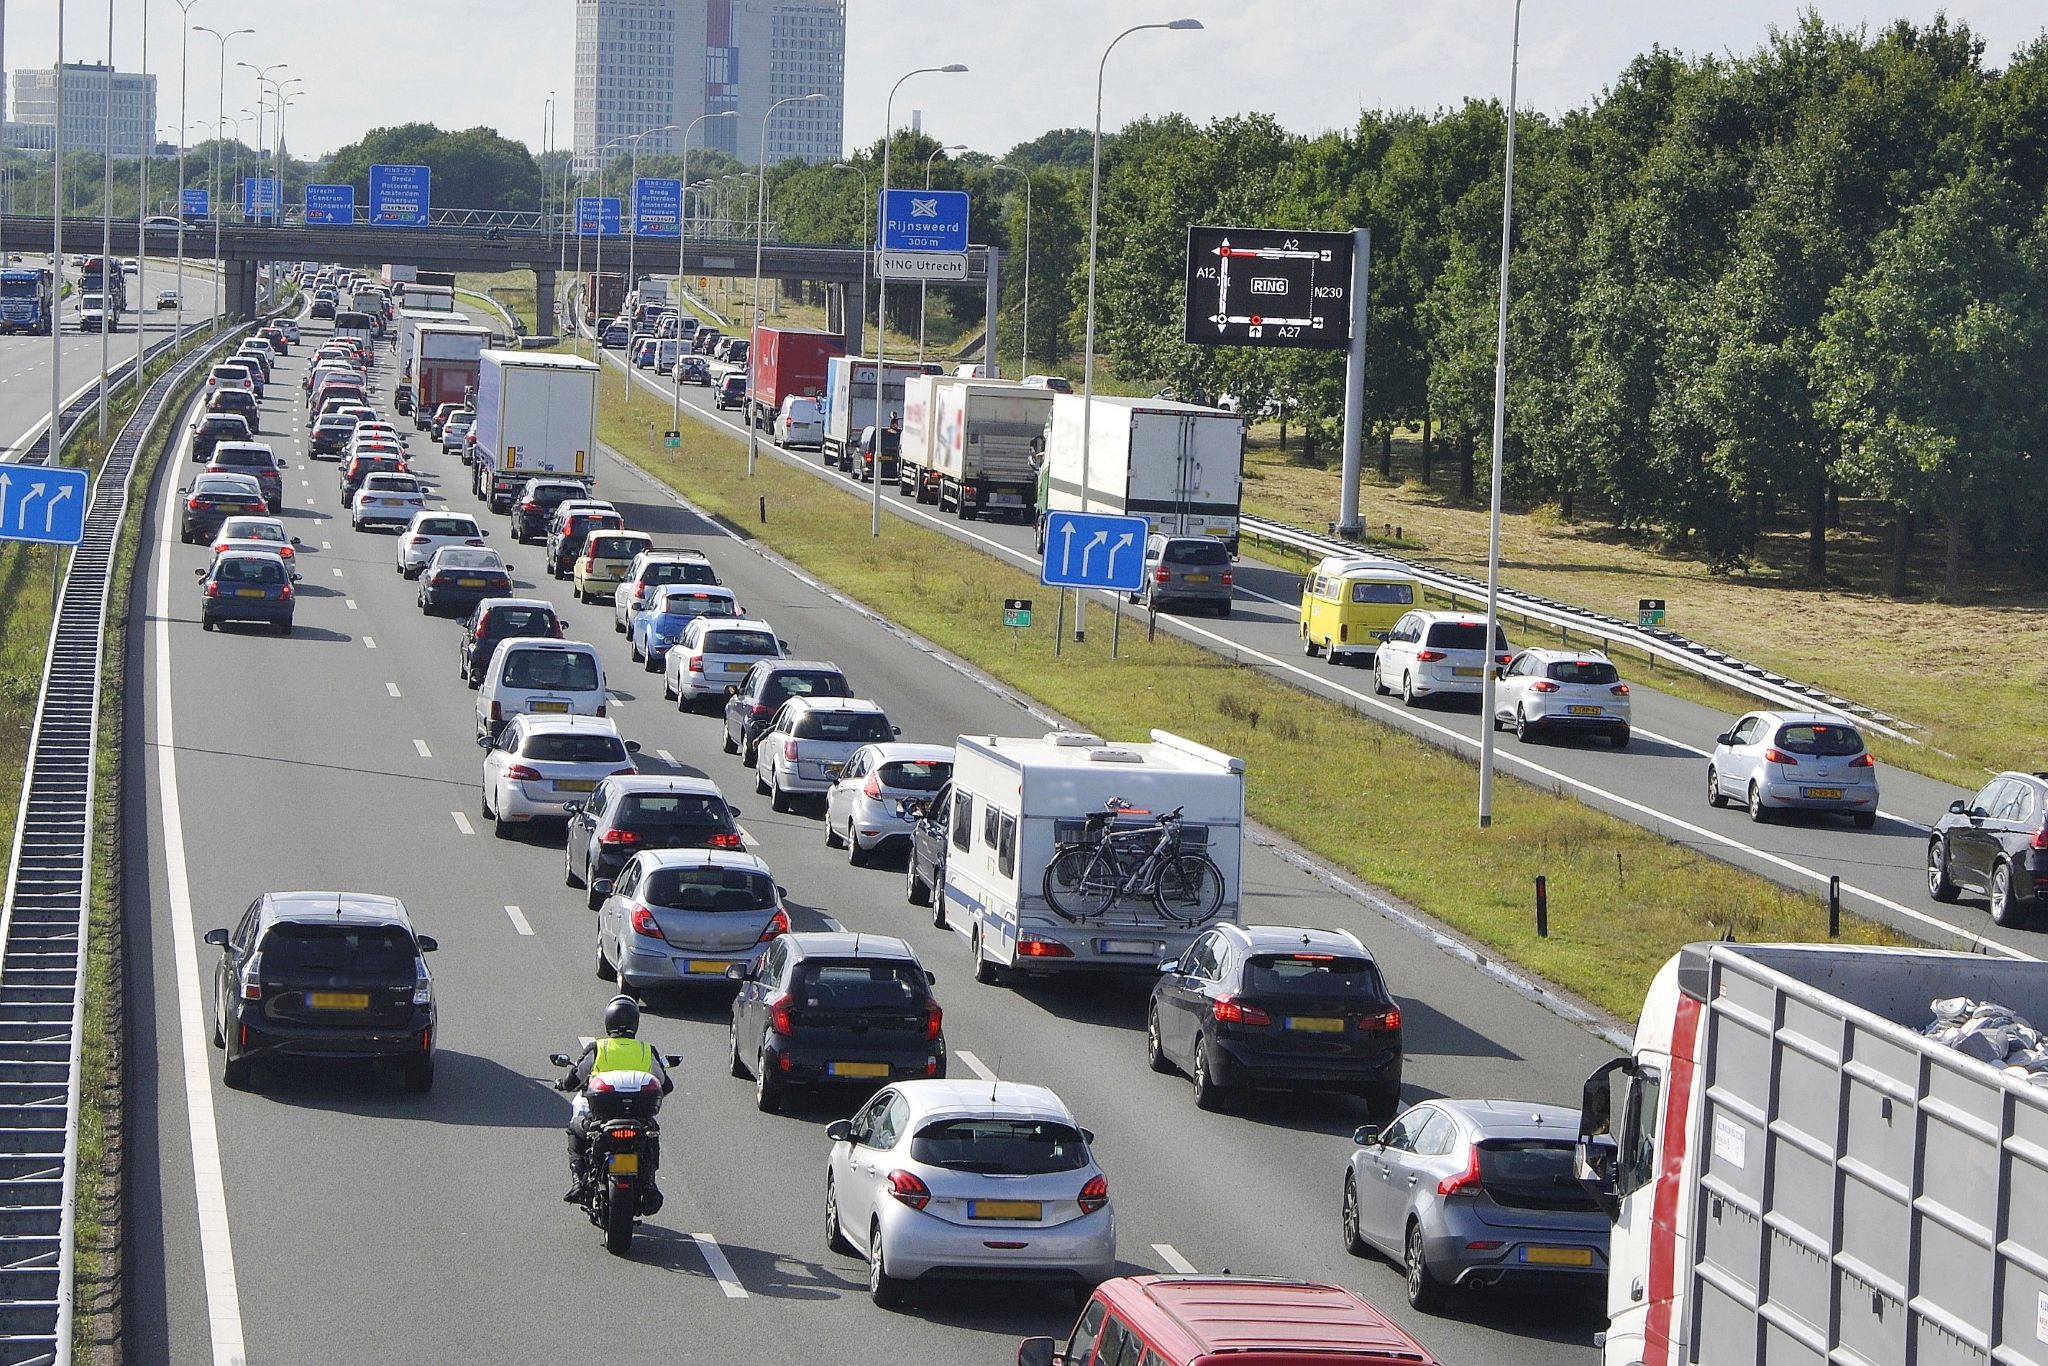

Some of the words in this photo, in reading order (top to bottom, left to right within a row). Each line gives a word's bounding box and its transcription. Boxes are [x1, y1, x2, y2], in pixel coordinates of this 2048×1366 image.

[888, 220, 959, 233] Rijnsweerd
[908, 238, 928, 246] 300
[929, 239, 939, 247] m
[1283, 239, 1300, 250] A2
[916, 259, 963, 272] Utrecht
[1196, 267, 1217, 279] A12
[1253, 280, 1285, 292] RING
[1314, 287, 1343, 299] N230
[1278, 327, 1301, 338] A27
